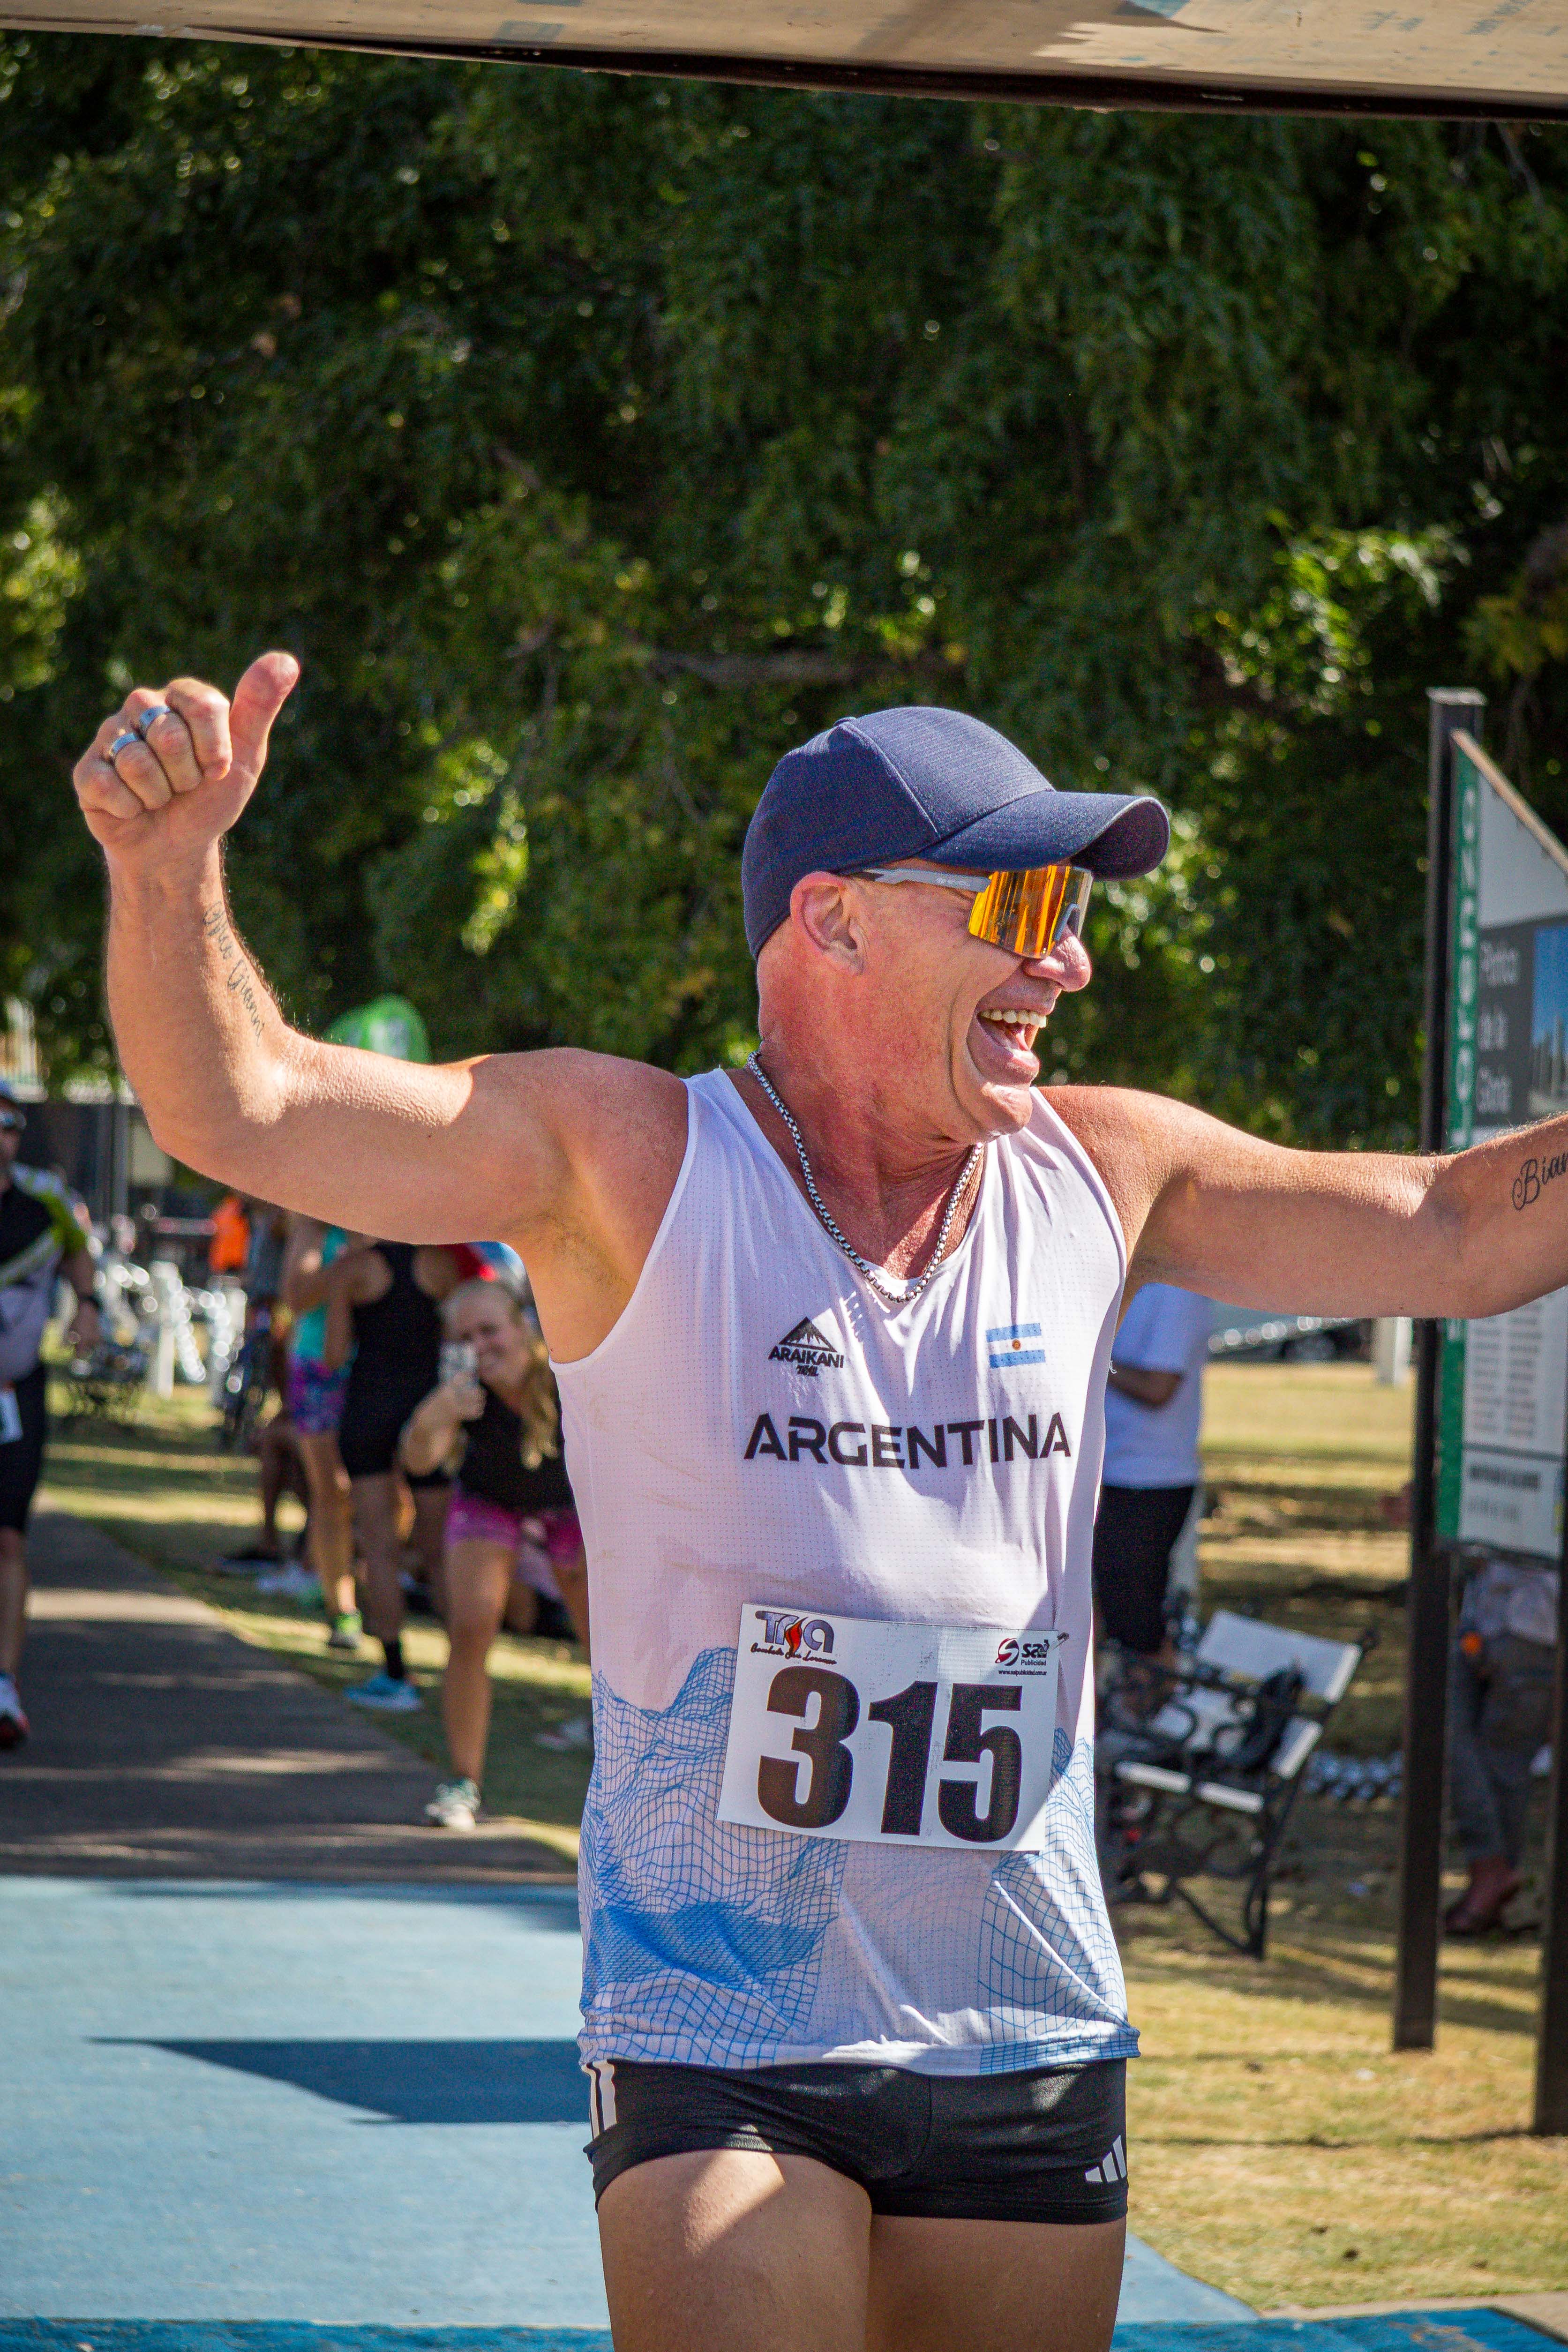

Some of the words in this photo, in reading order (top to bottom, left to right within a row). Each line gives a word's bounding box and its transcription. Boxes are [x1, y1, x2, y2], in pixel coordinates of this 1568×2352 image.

[767, 1345, 844, 1368] ARAIKANI
[743, 1412, 1072, 1469] ARGENTINA
[758, 1666, 1023, 1843] 315
